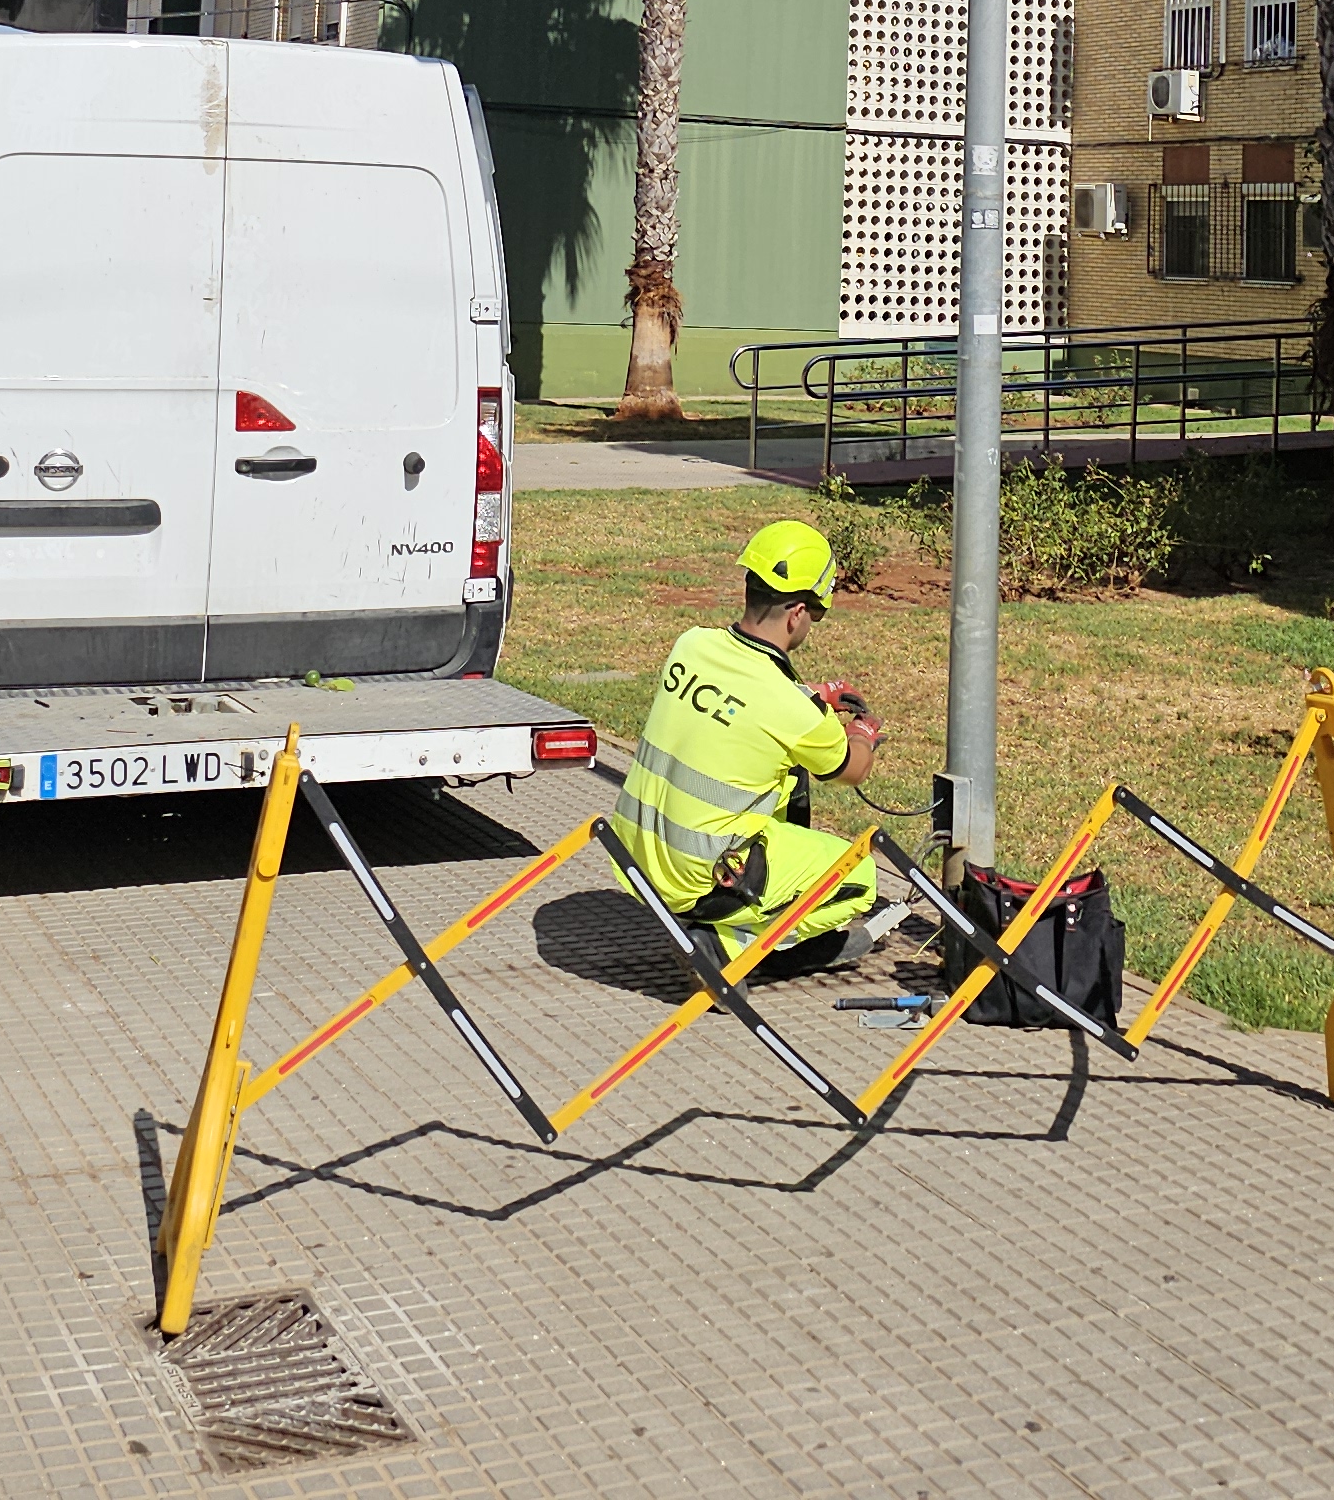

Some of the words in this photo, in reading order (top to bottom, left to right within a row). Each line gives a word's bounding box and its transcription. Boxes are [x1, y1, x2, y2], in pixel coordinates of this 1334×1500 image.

[38, 465, 80, 474] NISSAN
[391, 541, 454, 556] NV400
[663, 662, 747, 727] SICE
[44, 780, 53, 791] E
[66, 756, 149, 790] 3502
[162, 752, 221, 784] LWD
